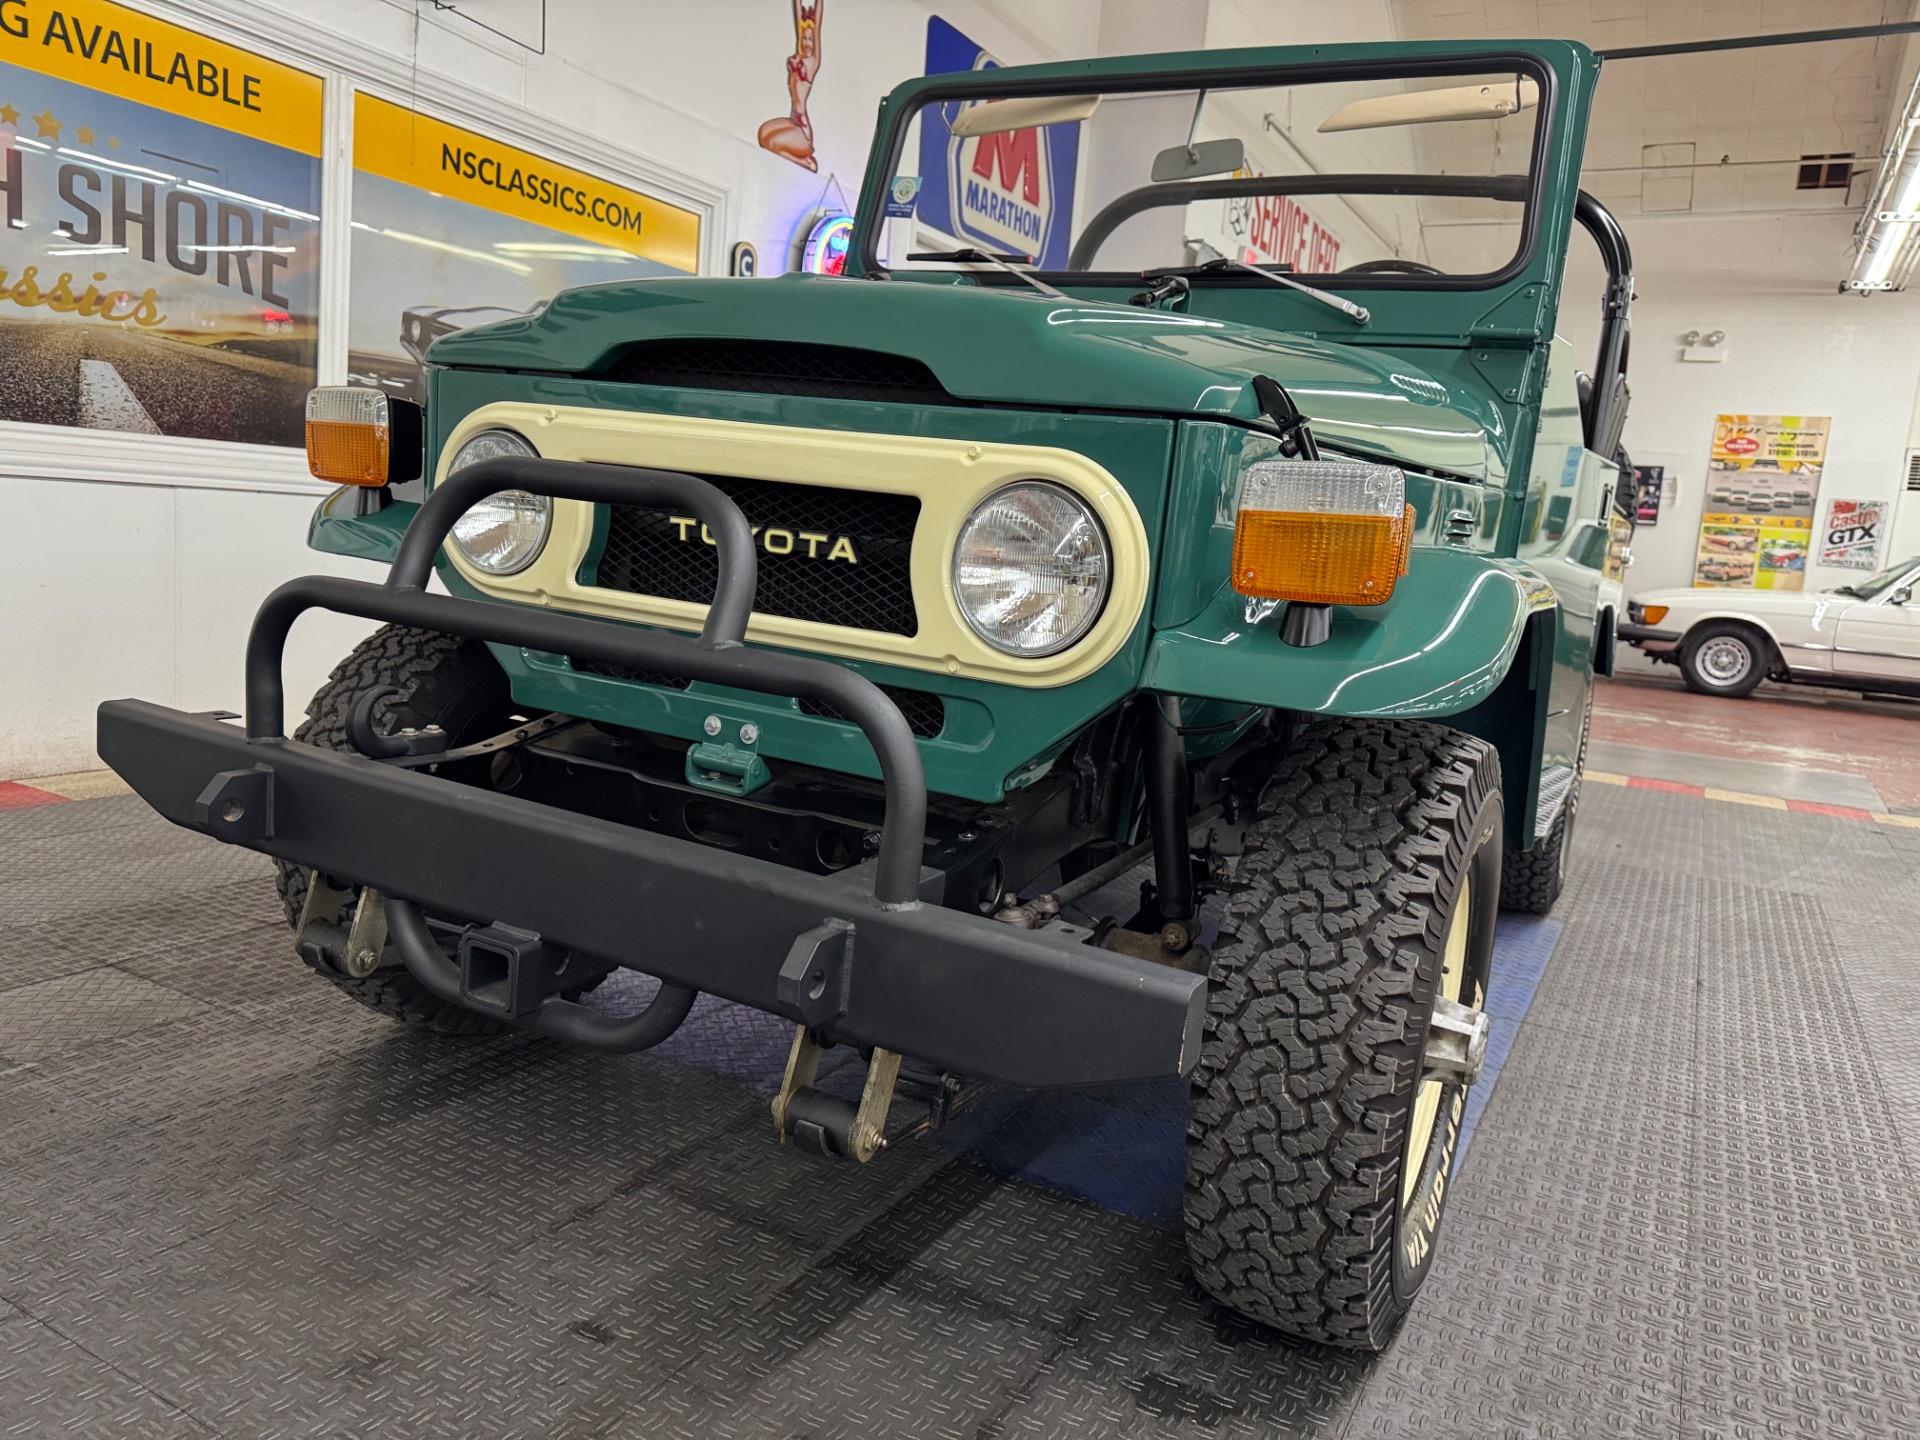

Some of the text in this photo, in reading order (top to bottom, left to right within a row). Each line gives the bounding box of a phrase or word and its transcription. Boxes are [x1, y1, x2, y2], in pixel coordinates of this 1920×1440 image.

[42, 10, 262, 113] AVAILABLE
[441, 143, 642, 235] NSCLASSICS.COM
[965, 179, 1041, 242] MARATHON
[58, 163, 291, 310] SHORE
[1250, 194, 1309, 274] SERVICE
[669, 515, 858, 564] TOTA
[1828, 522, 1877, 545] GTX
[1829, 509, 1879, 529] Castro
